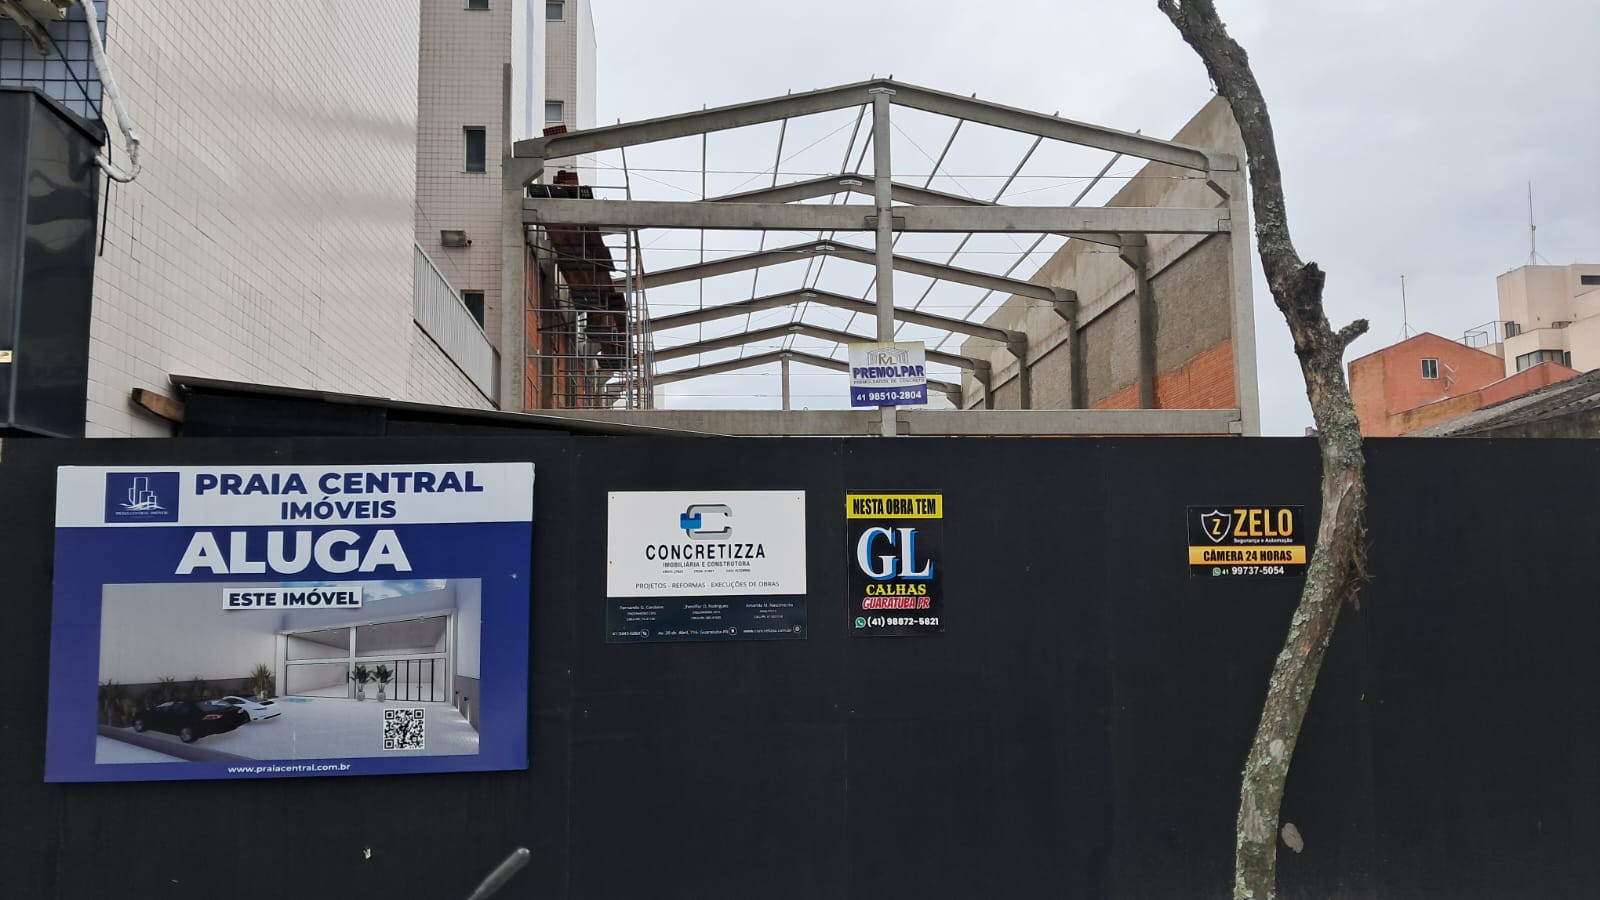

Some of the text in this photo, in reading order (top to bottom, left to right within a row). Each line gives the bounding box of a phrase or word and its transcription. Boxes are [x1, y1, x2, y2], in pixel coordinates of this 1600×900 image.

[852, 365, 925, 379] PREMOLPAR
[857, 391, 922, 401] 41 98510-2804
[195, 471, 484, 496] PRAIA CENTRAL
[281, 498, 397, 520] IMÓVEIS
[853, 498, 936, 515] NESTA OBRA TEM
[1212, 518, 1222, 535] Z
[1233, 508, 1293, 537] ZELO
[175, 529, 412, 575] ALUGA
[645, 543, 766, 560] CONCRETIZZA
[856, 526, 935, 581] GL
[1203, 549, 1293, 562] CÂMERA 24 HORAS
[1231, 566, 1284, 575] 99737-5054
[635, 582, 667, 590] PROJETOS
[710, 580, 747, 589] EXECUÇÕES
[865, 584, 927, 596] CALHAS
[229, 589, 360, 607] ESTE IMÓVEL
[862, 596, 931, 610] GUARATUBA PR
[867, 616, 939, 628] (41) 98872-5821
[227, 763, 351, 774] www.praiacentral.com.br
